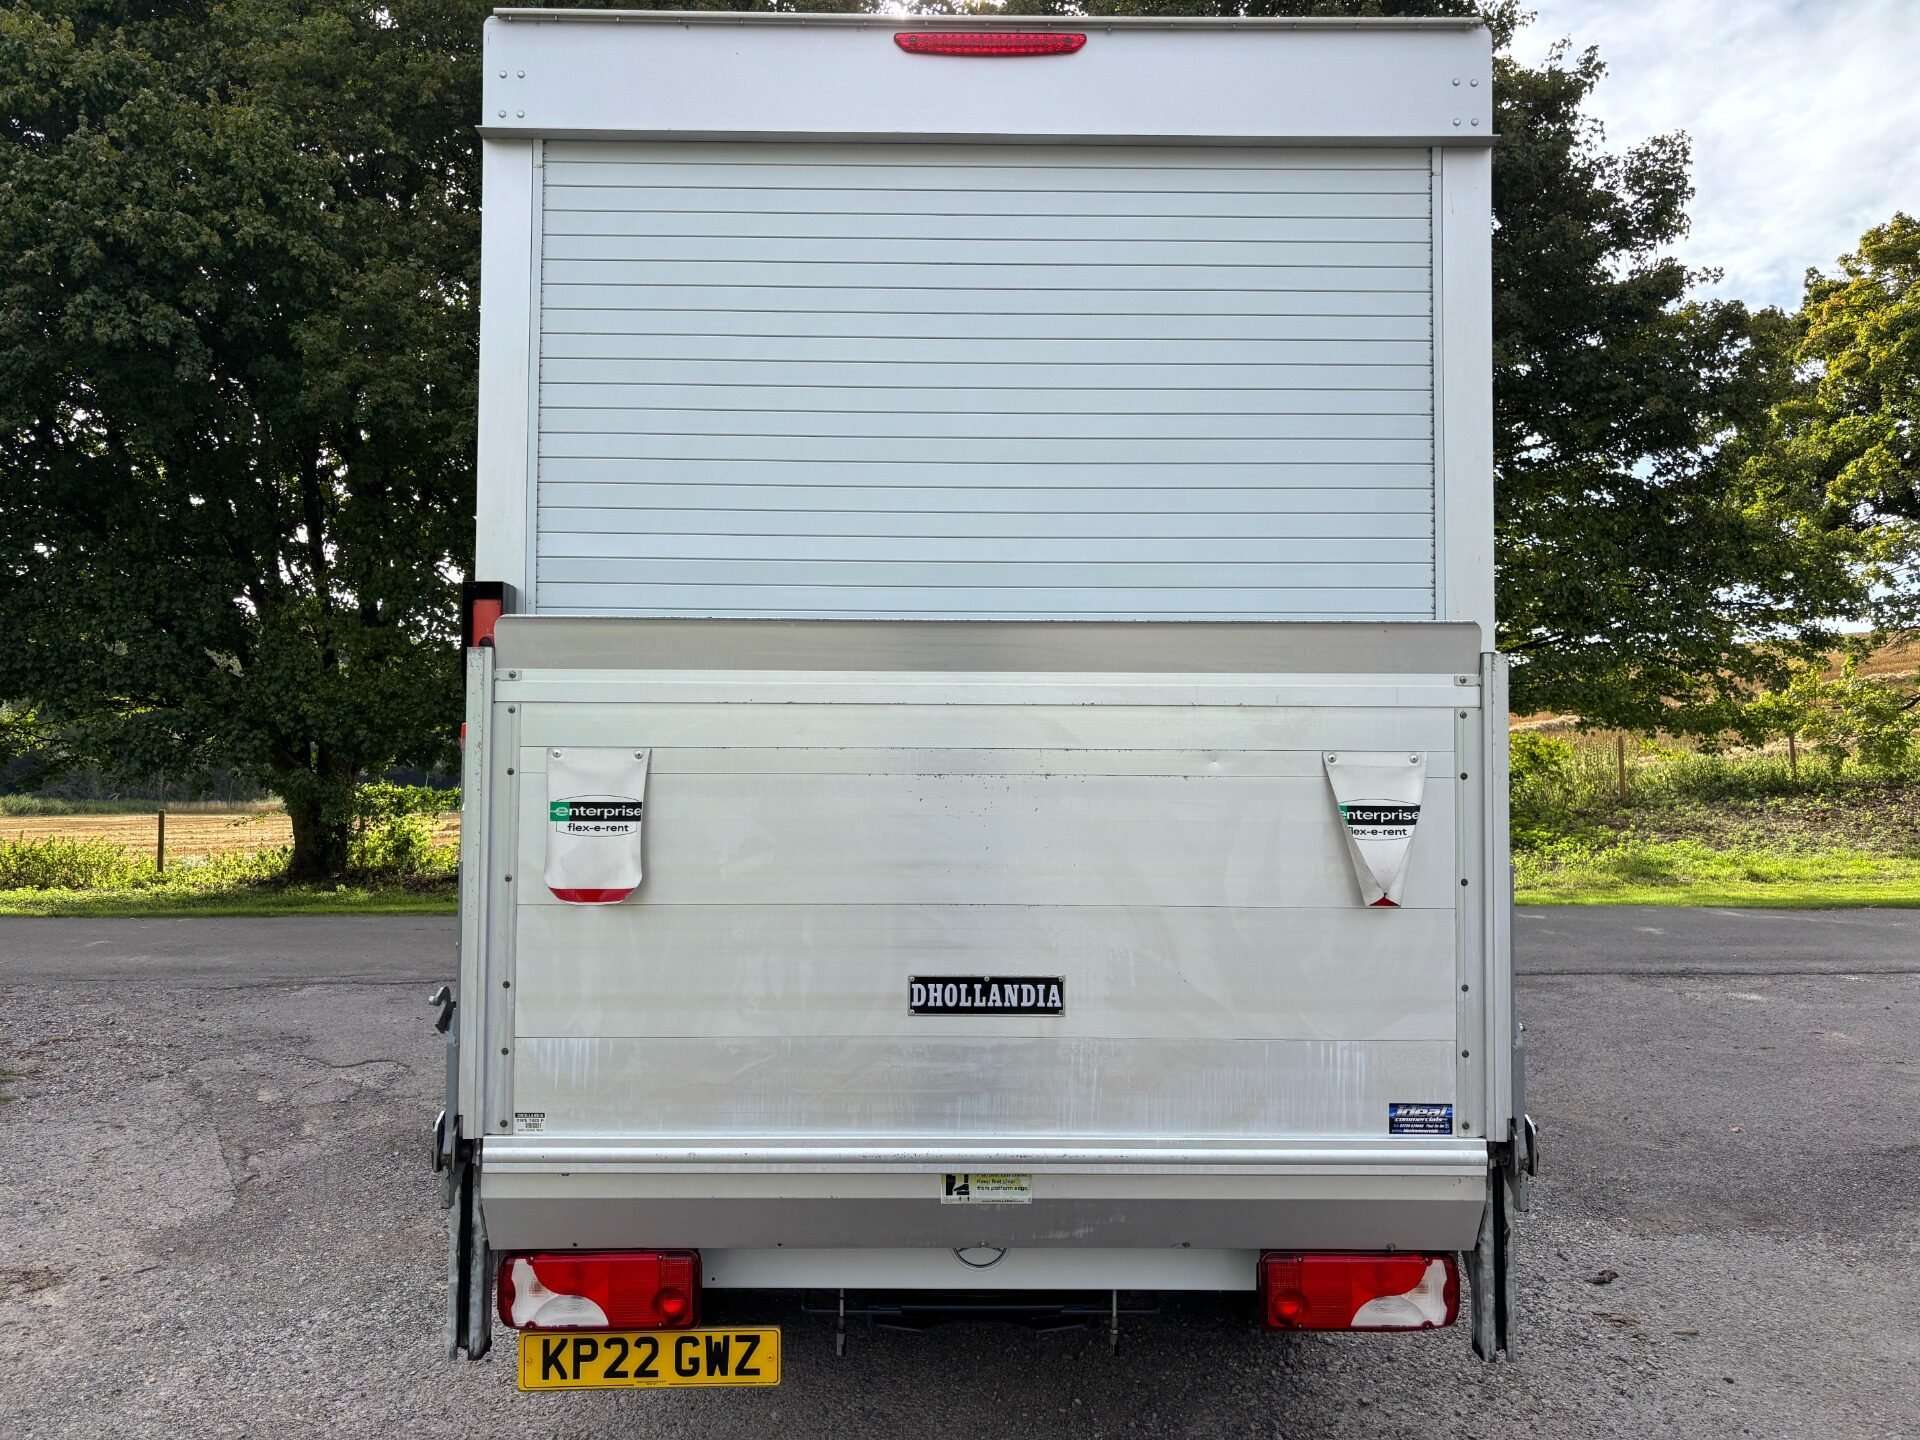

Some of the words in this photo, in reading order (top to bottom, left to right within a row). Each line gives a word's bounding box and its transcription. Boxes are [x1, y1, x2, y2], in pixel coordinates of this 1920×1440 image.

[554, 805, 642, 820] enterprise
[568, 822, 629, 832] flex-e-rent
[911, 983, 1062, 1008] DHOLLANDIA
[1396, 1105, 1448, 1117] ideal
[541, 1336, 660, 1381] KP22
[674, 1334, 761, 1378] GWZ
